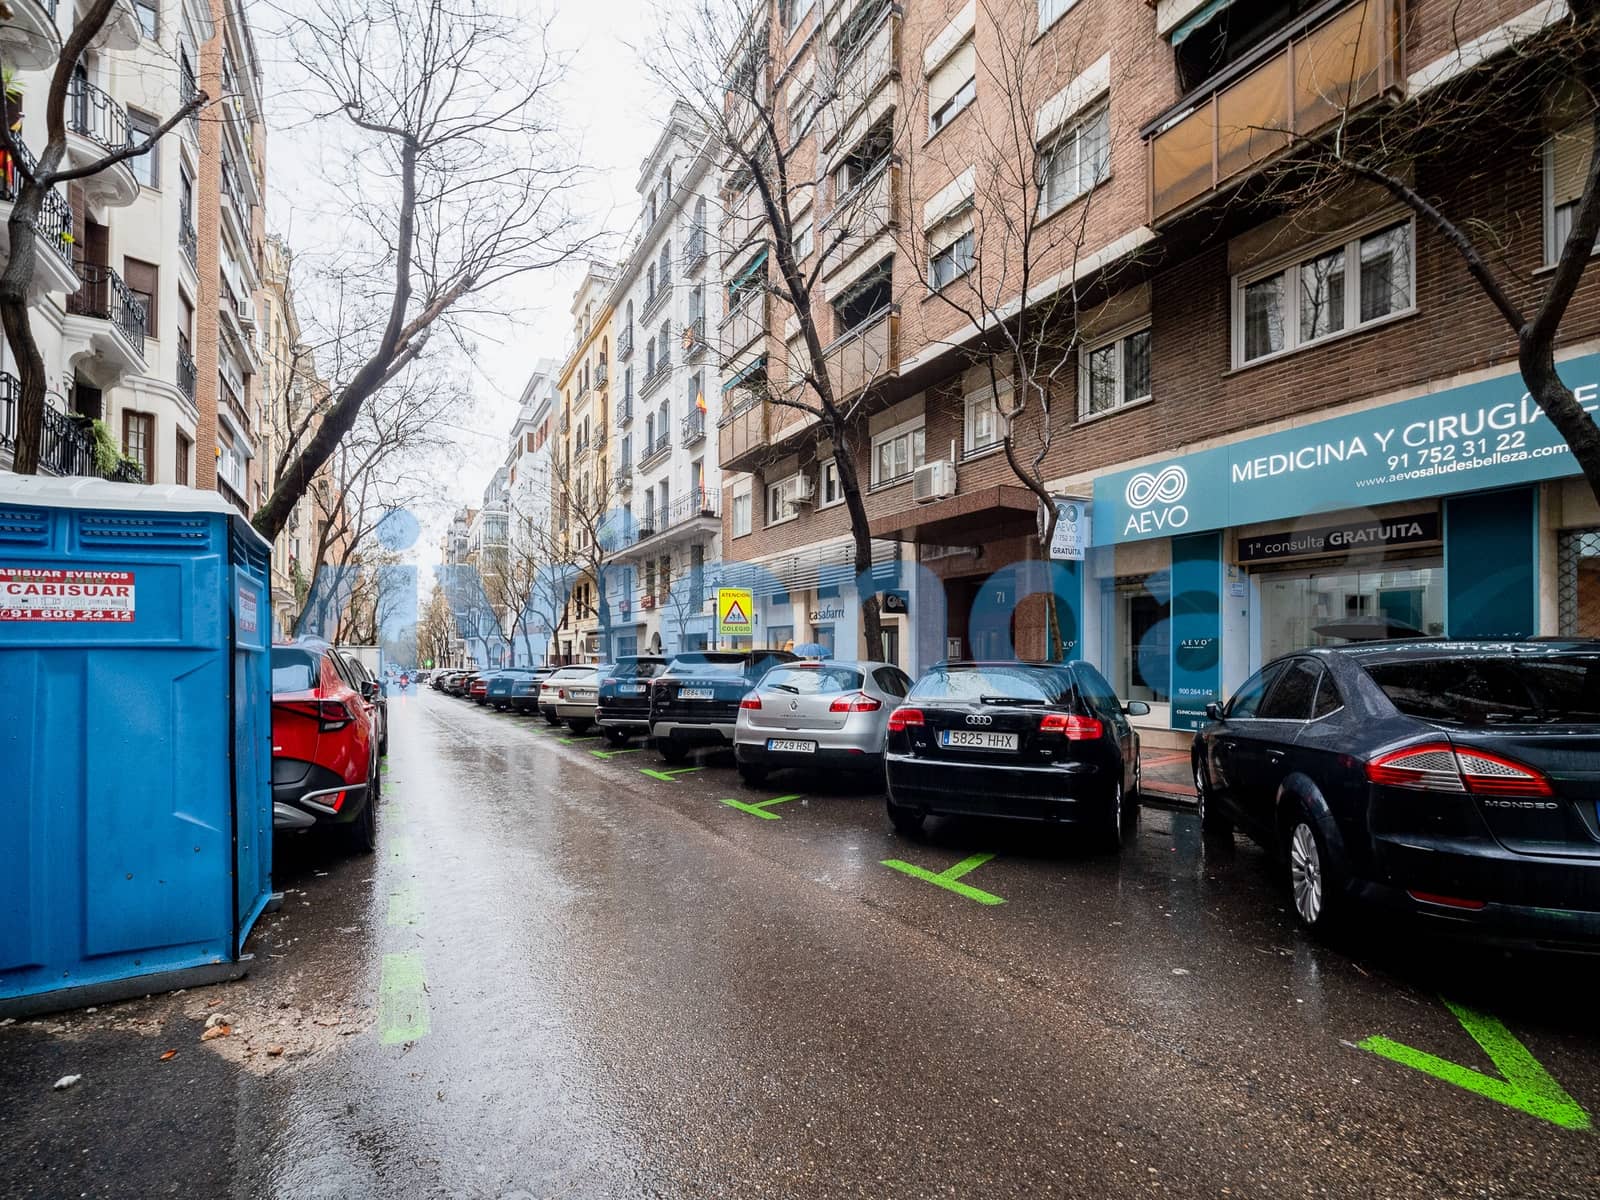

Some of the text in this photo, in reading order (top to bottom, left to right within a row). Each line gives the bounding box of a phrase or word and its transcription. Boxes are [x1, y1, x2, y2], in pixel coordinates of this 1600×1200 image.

[1232, 436, 1368, 483] MEDICINA
[1373, 429, 1395, 452] Y
[1387, 431, 1526, 471] 91 752 31 22
[1355, 444, 1569, 488] www.aevosaludesbelleza.com
[1124, 506, 1189, 536] AEVO
[1265, 536, 1325, 553] consulta
[1329, 522, 1422, 545] GRATUITA
[1052, 546, 1081, 556] GRATUITA
[66, 570, 128, 579] EVENTOS
[6, 583, 130, 597] CABISUAR
[996, 591, 1005, 604] 71
[10, 609, 131, 618] 91 606 24 12
[773, 740, 813, 752] 2749 HSL
[952, 731, 1012, 748] 5825 HHX
[1484, 800, 1558, 809] MONDEO
